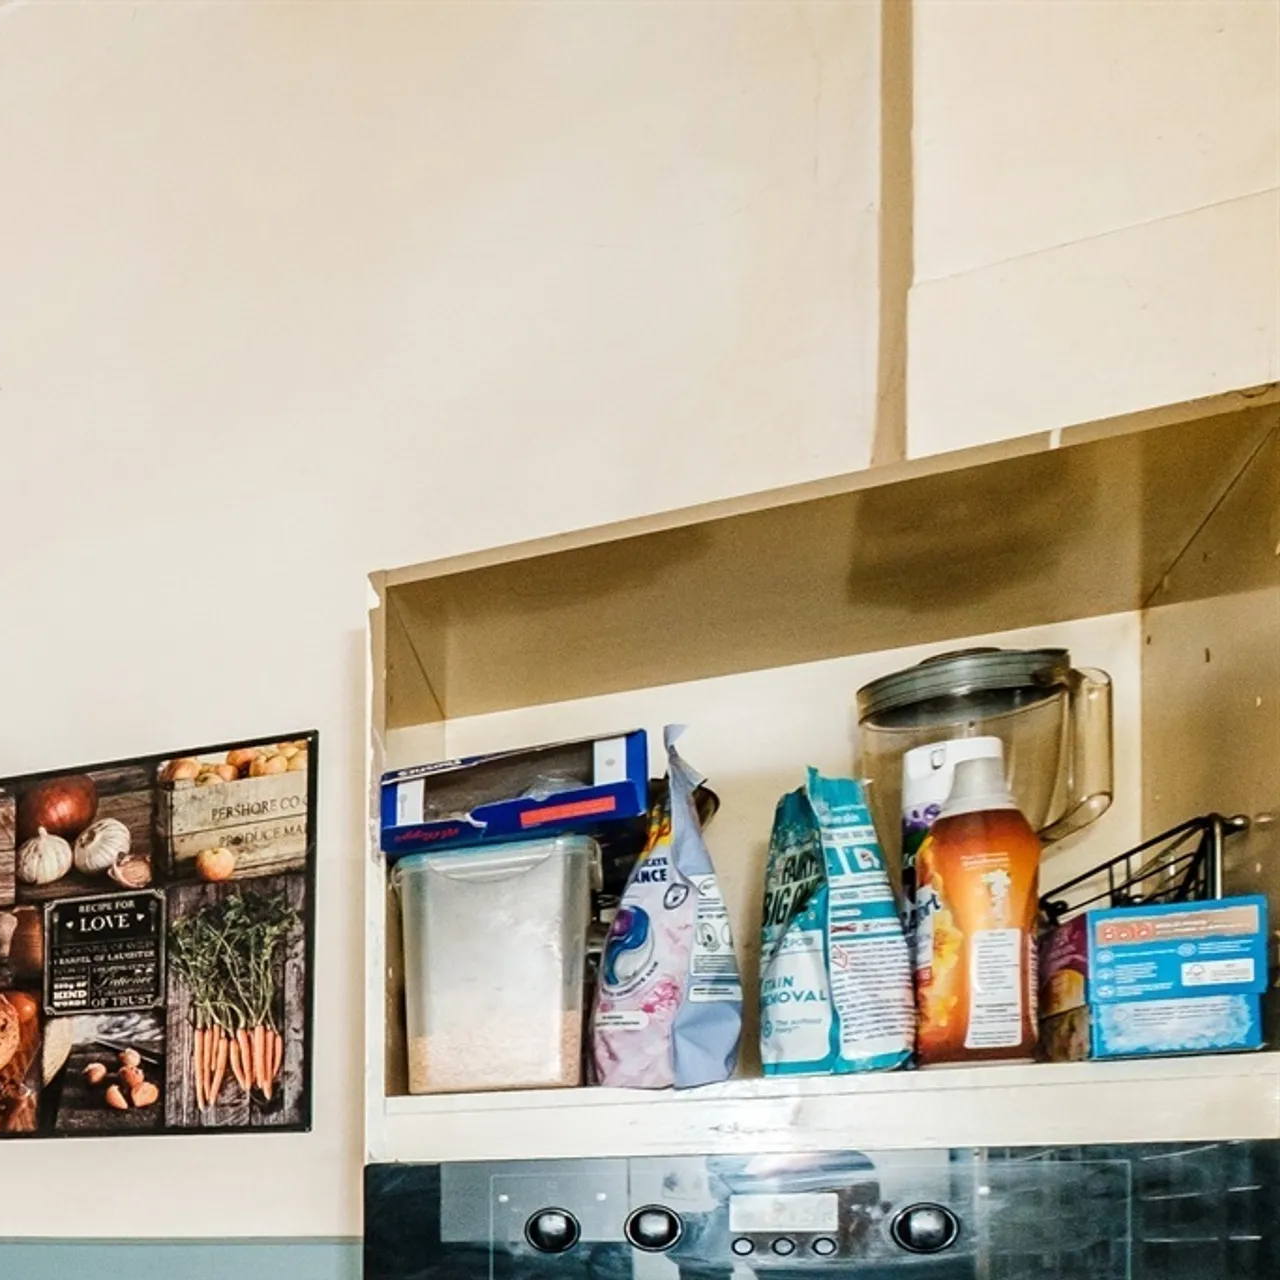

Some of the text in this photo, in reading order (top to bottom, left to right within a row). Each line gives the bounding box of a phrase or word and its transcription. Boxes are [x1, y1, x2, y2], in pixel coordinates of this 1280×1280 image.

[210, 798, 278, 822] PERSHORE
[78, 899, 136, 914] RECIPE FOR
[80, 912, 131, 932] LOVE
[53, 989, 88, 1001] KIND
[91, 993, 154, 1008] OF TRUST
